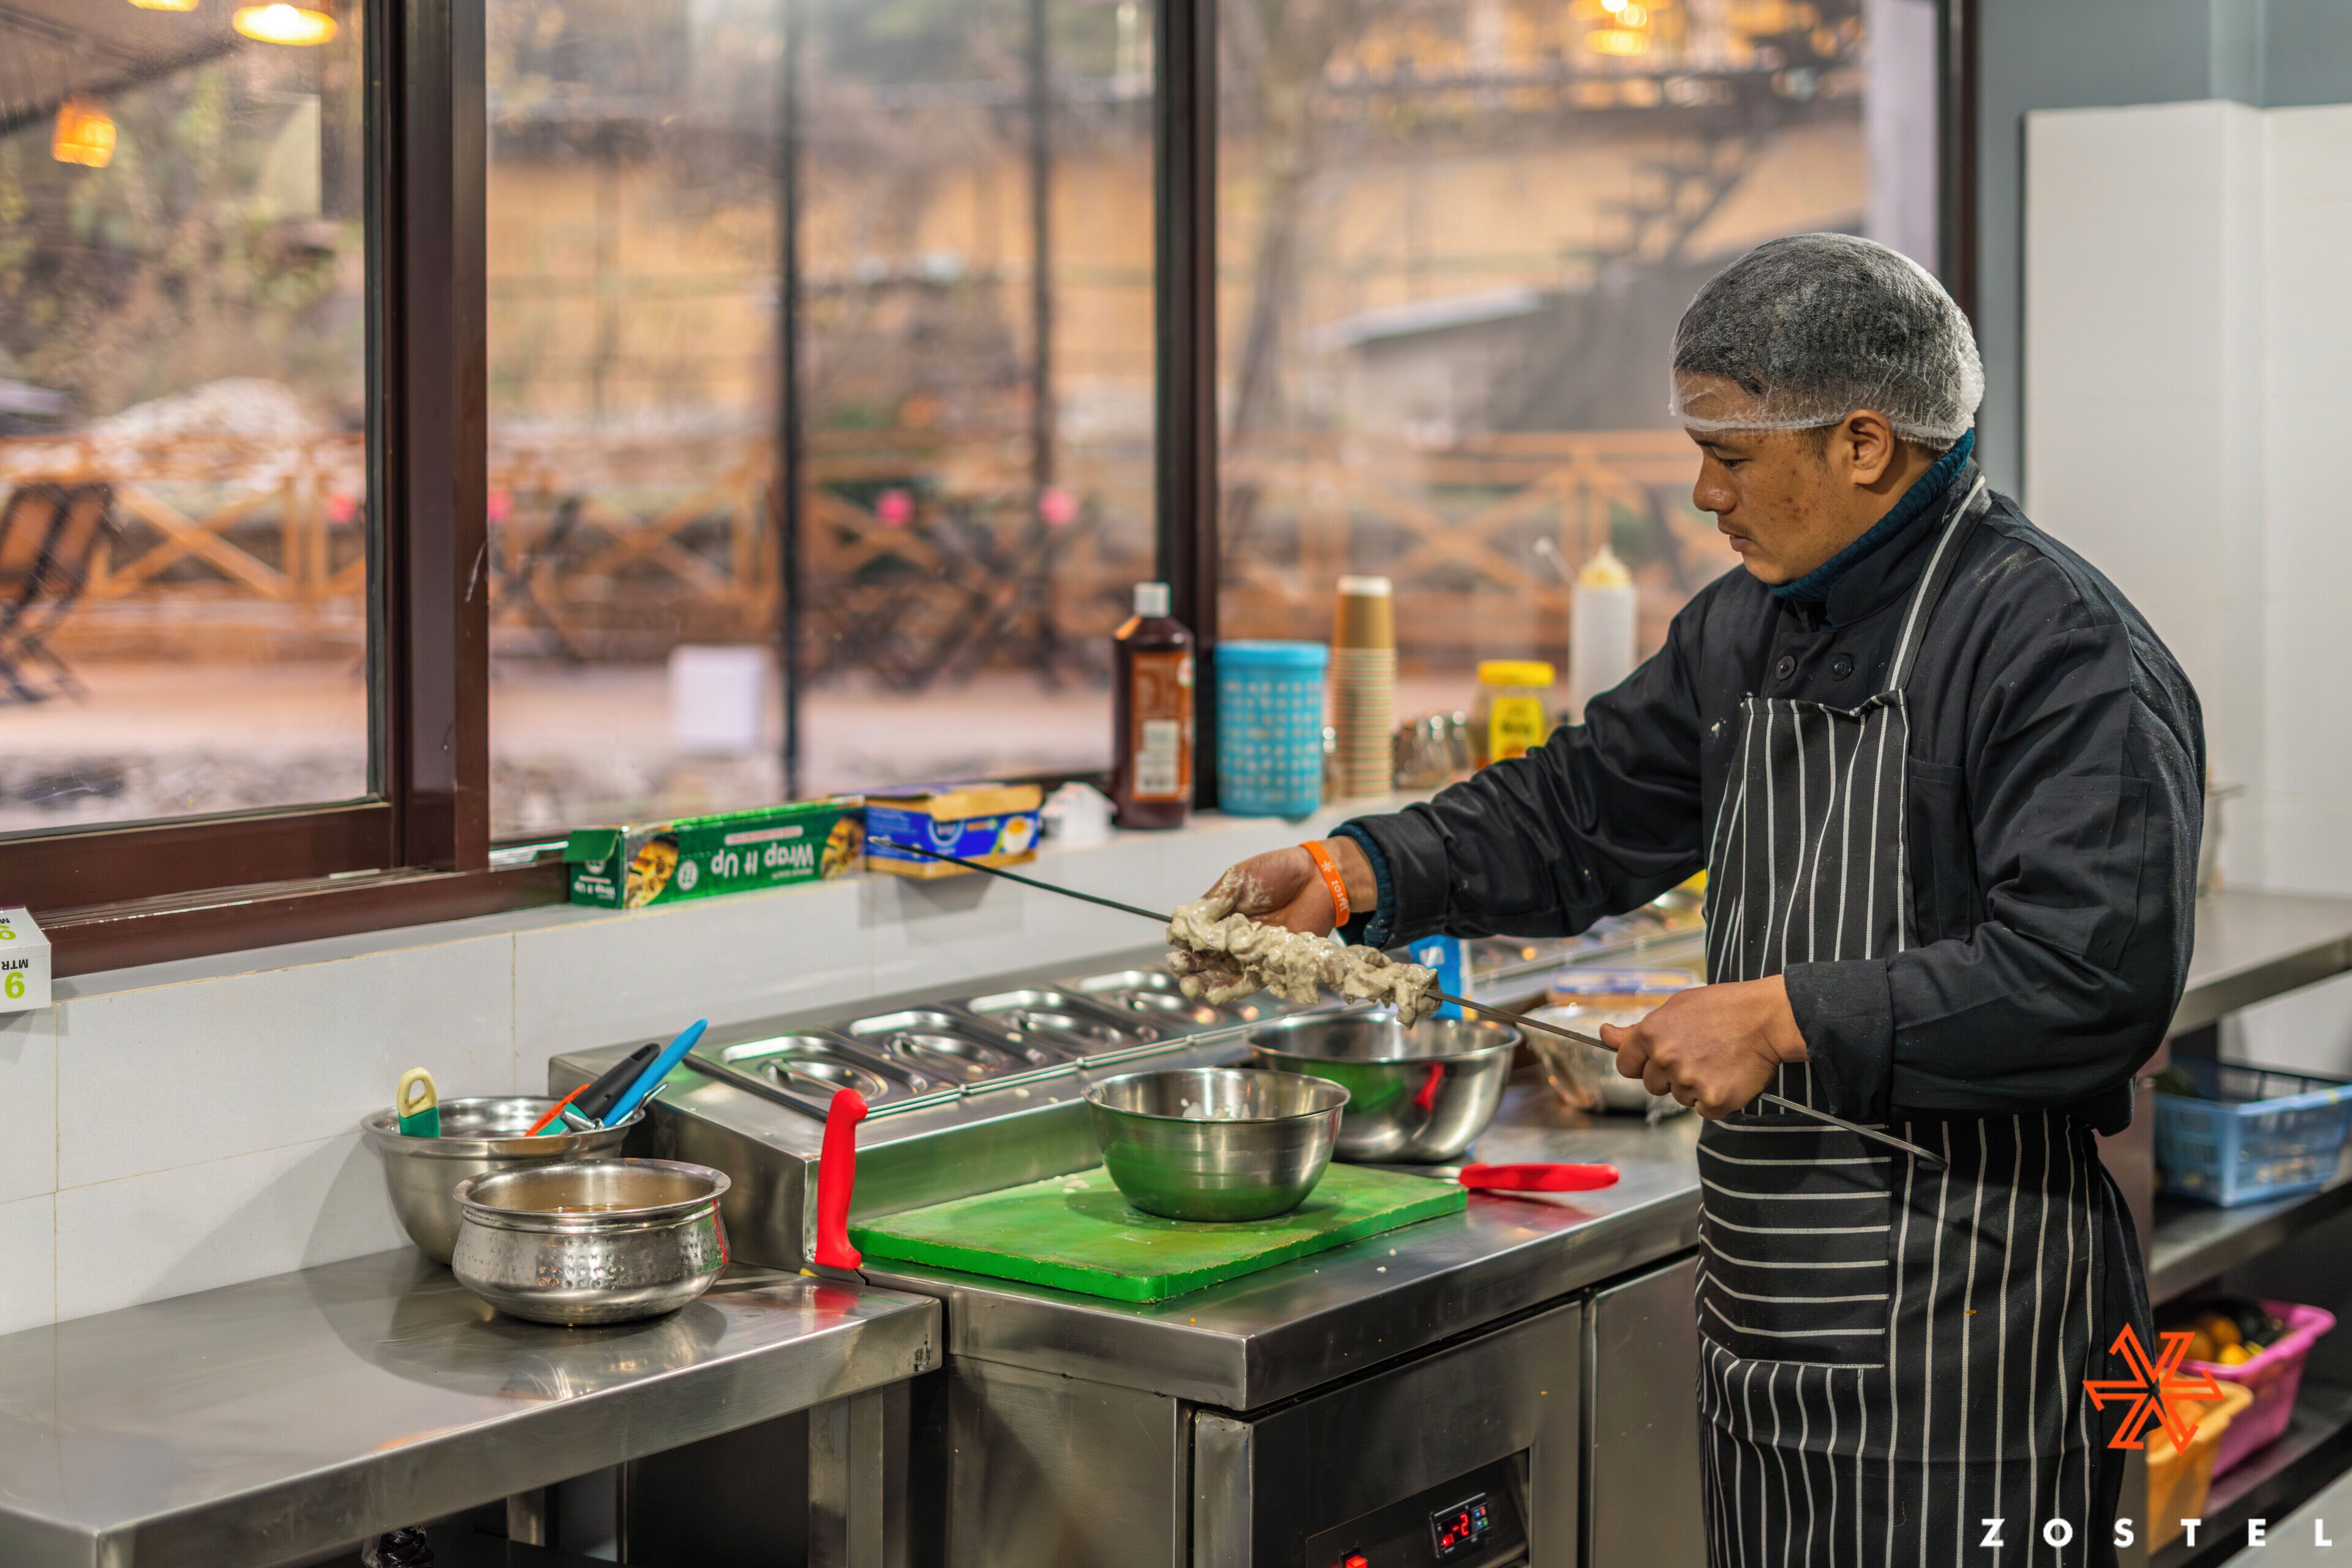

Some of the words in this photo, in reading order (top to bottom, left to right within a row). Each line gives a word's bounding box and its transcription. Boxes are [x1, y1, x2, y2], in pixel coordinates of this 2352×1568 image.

[710, 849, 739, 878] Up
[744, 851, 758, 875] It
[764, 842, 813, 867] Wrap
[1, 959, 29, 970] MTR
[5, 971, 25, 999] 9
